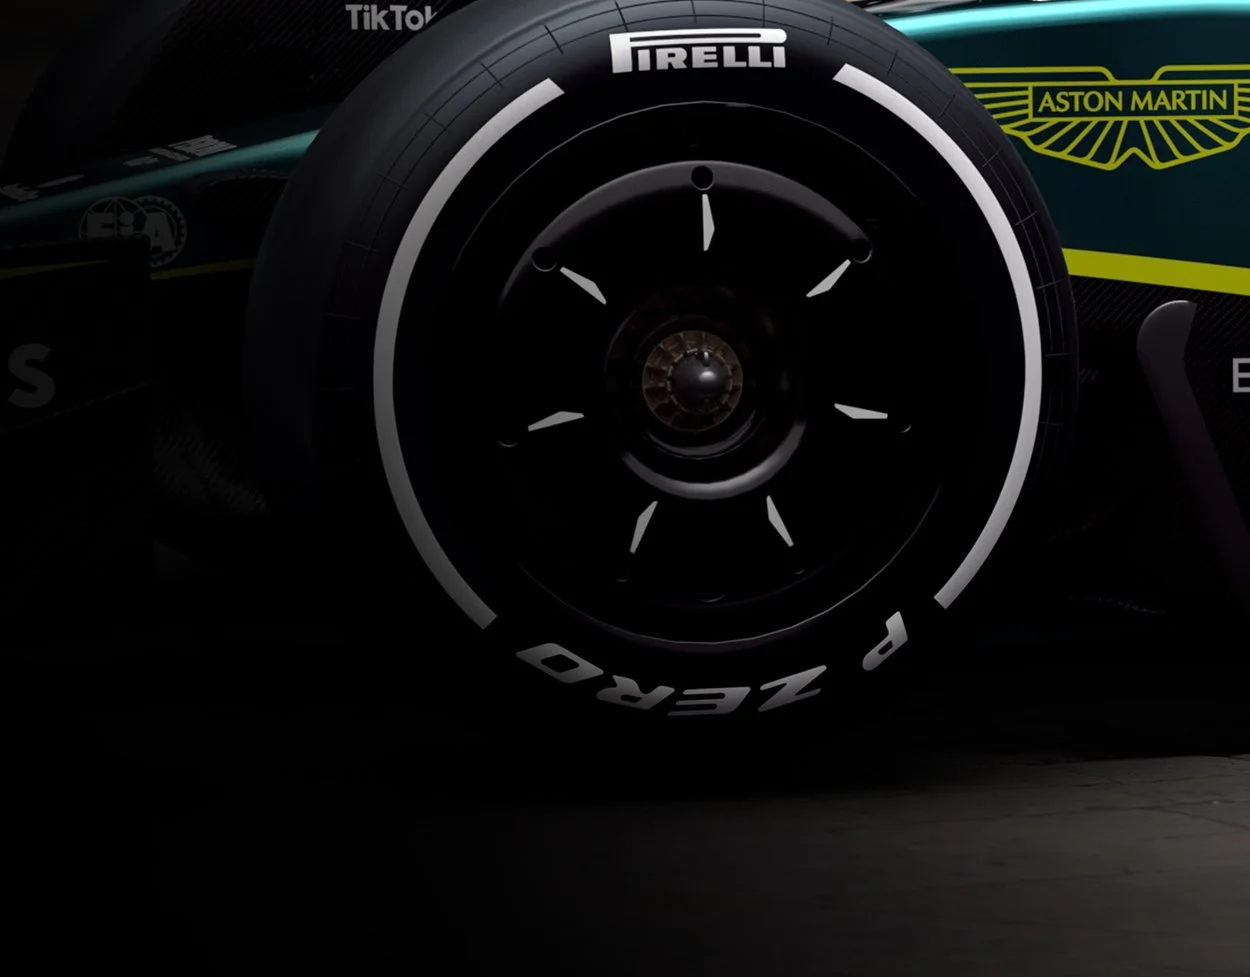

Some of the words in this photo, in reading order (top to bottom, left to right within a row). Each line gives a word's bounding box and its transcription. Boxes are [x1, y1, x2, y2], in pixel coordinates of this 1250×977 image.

[609, 28, 788, 74] PIRELLI
[1037, 90, 1124, 113] ASTON
[1130, 89, 1228, 112] MARTIN
[862, 610, 909, 672] P
[515, 642, 828, 716] ZERO
